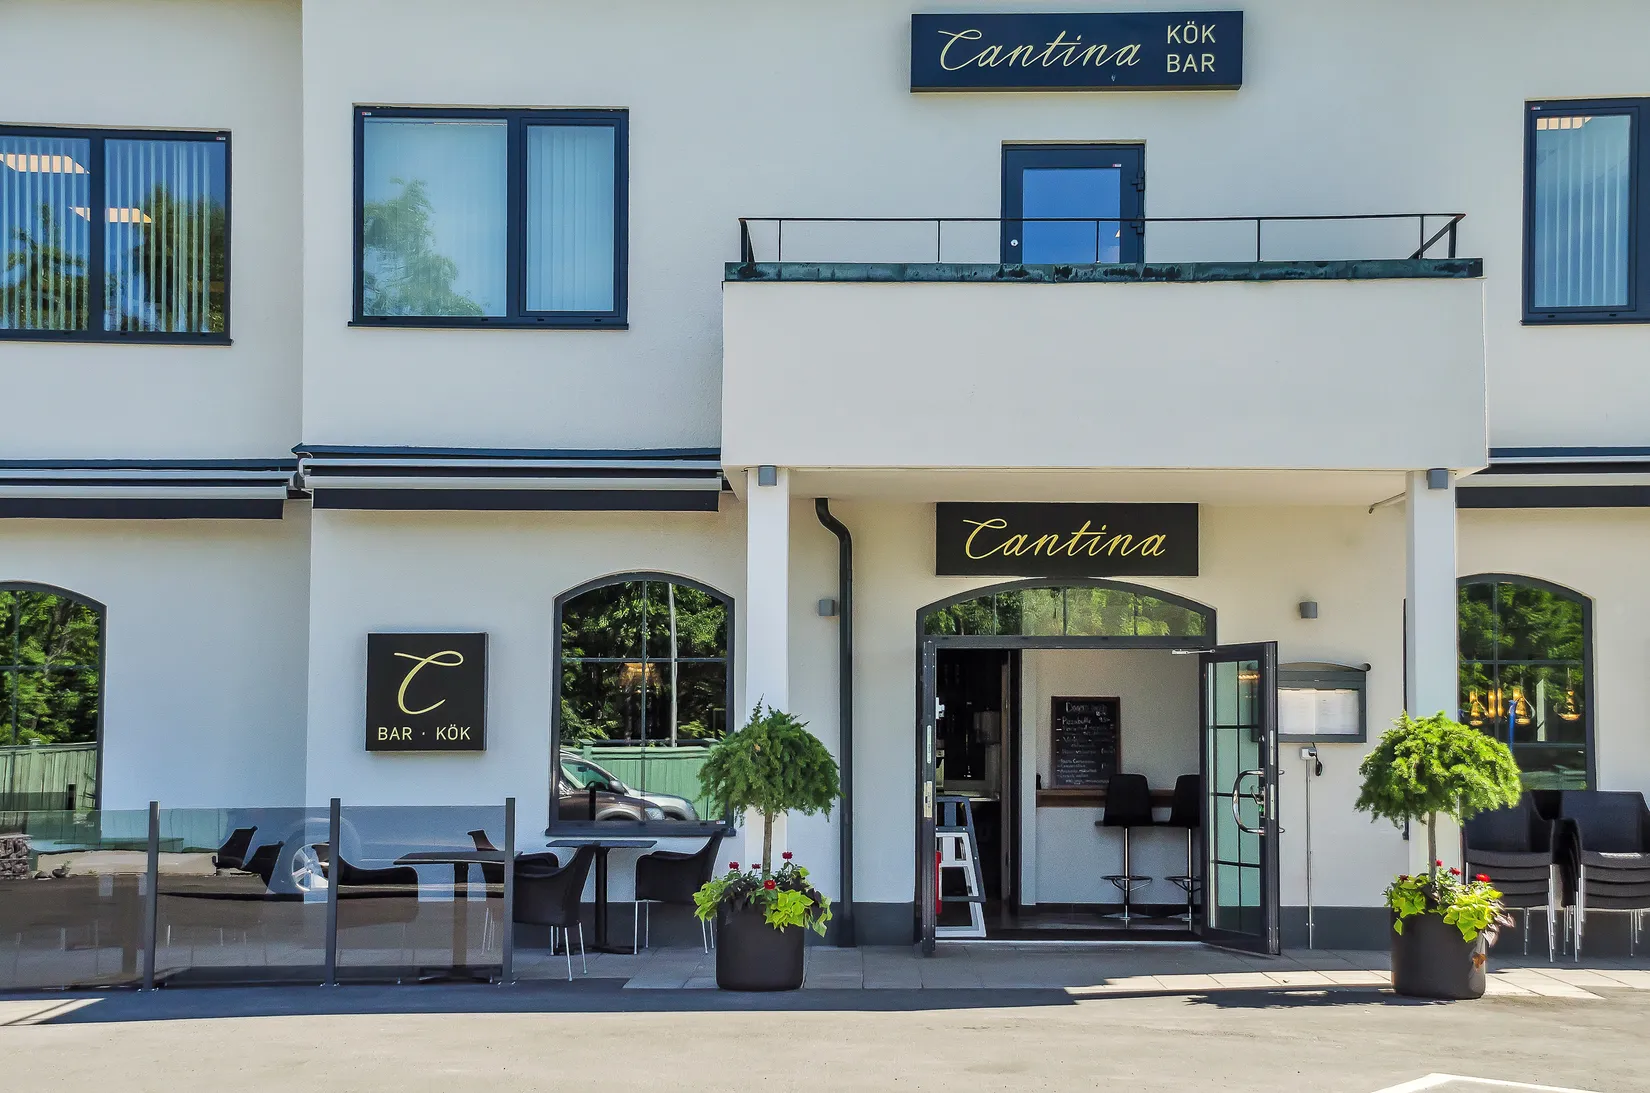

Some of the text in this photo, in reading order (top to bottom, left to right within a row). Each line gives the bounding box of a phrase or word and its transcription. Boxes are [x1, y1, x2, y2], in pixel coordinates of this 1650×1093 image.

[1166, 20, 1216, 44] KÖK
[937, 29, 1141, 71] Cantina
[1166, 54, 1216, 73] BAR
[962, 518, 1167, 560] Cantina
[393, 650, 464, 715] C
[378, 723, 471, 741] BAR KÖK
